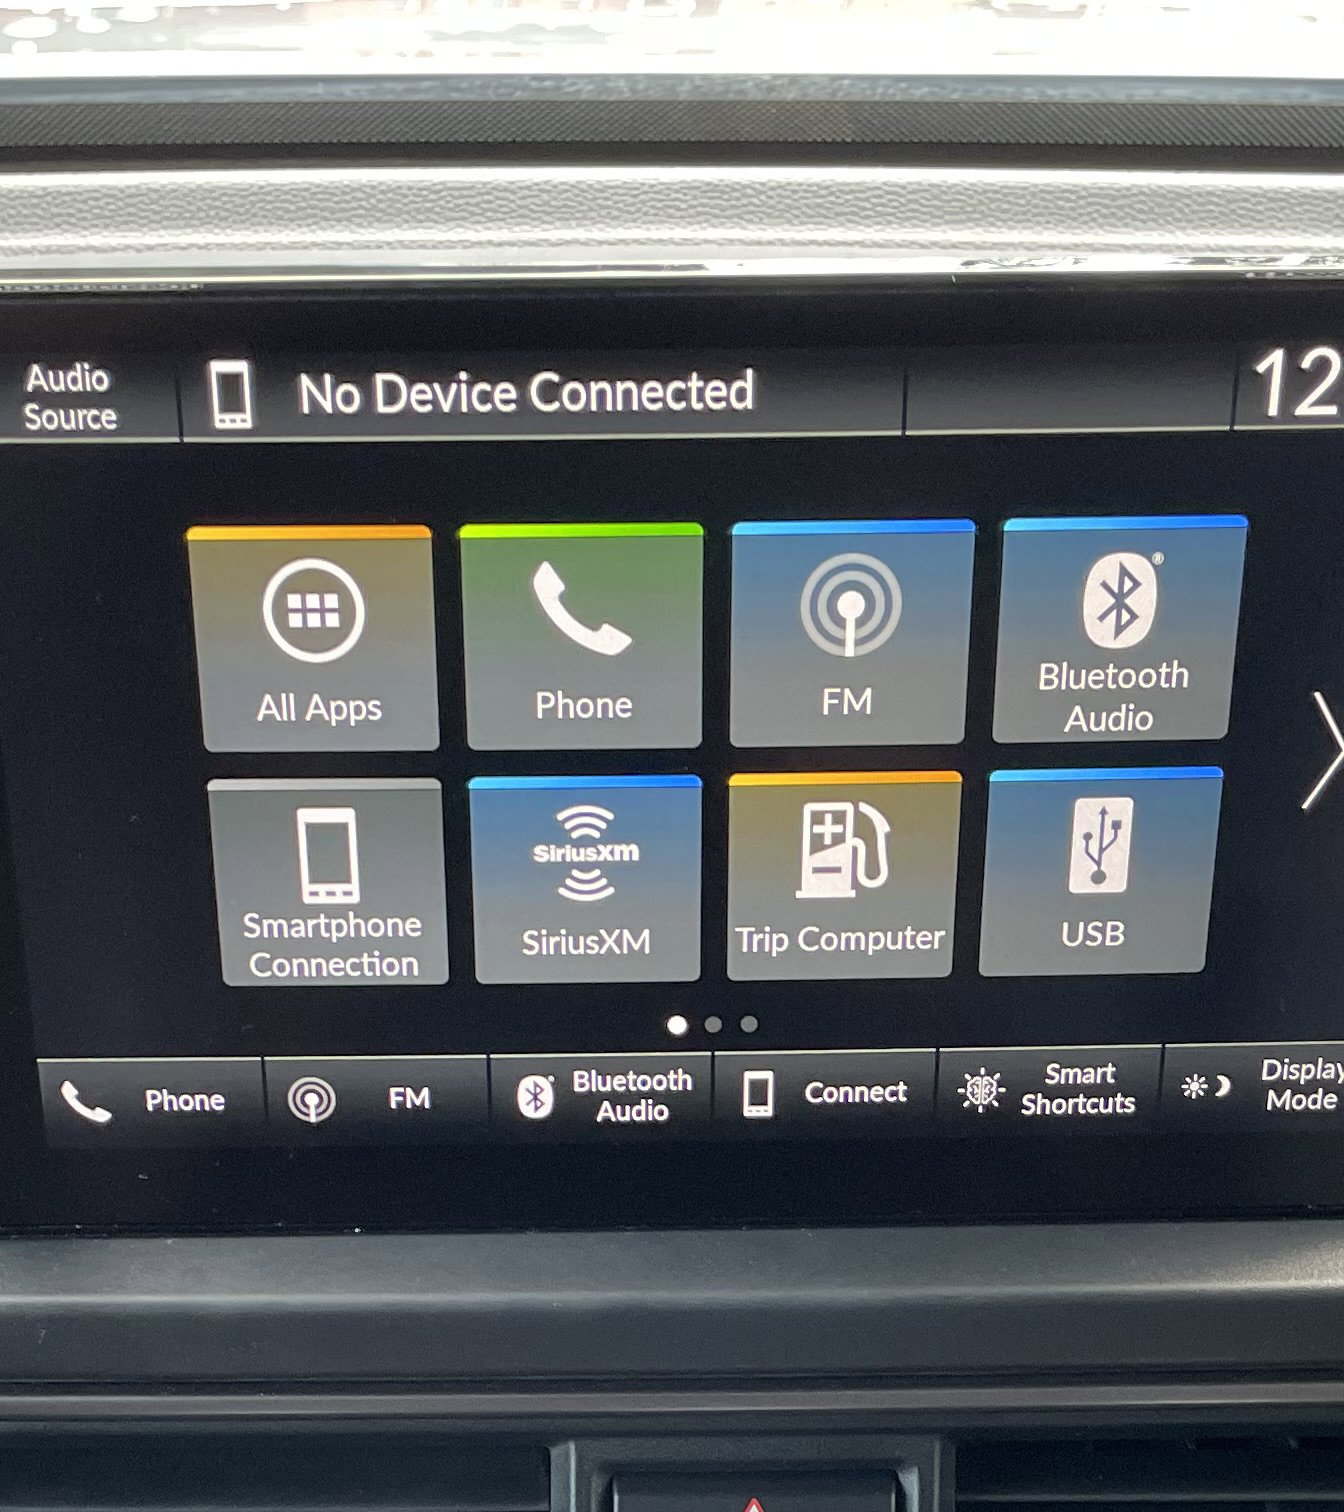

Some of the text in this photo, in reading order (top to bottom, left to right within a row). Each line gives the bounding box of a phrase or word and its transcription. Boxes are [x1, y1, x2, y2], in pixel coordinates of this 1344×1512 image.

[26, 362, 109, 393] Audio
[299, 368, 755, 415] No Device Connected
[24, 404, 118, 430] Source
[1039, 659, 1189, 691] Bluetooth
[257, 693, 383, 727] All Apps
[535, 690, 633, 719] Phone
[821, 688, 872, 715] FM
[1063, 703, 1154, 733] Audio
[242, 911, 422, 943] Smartphone
[1061, 921, 1125, 948] USB
[521, 928, 651, 956] SiriusXM
[735, 925, 946, 958] Trip Computer
[249, 952, 420, 979] Connection
[572, 1069, 693, 1094] Bluetooth
[1044, 1062, 1116, 1086] Smart
[145, 1088, 226, 1113] Phone
[389, 1087, 431, 1110] FM
[804, 1079, 908, 1104] Connect
[1020, 1090, 1136, 1117] Shortcuts
[1266, 1088, 1338, 1112] Mode
[596, 1098, 670, 1123] Audio
